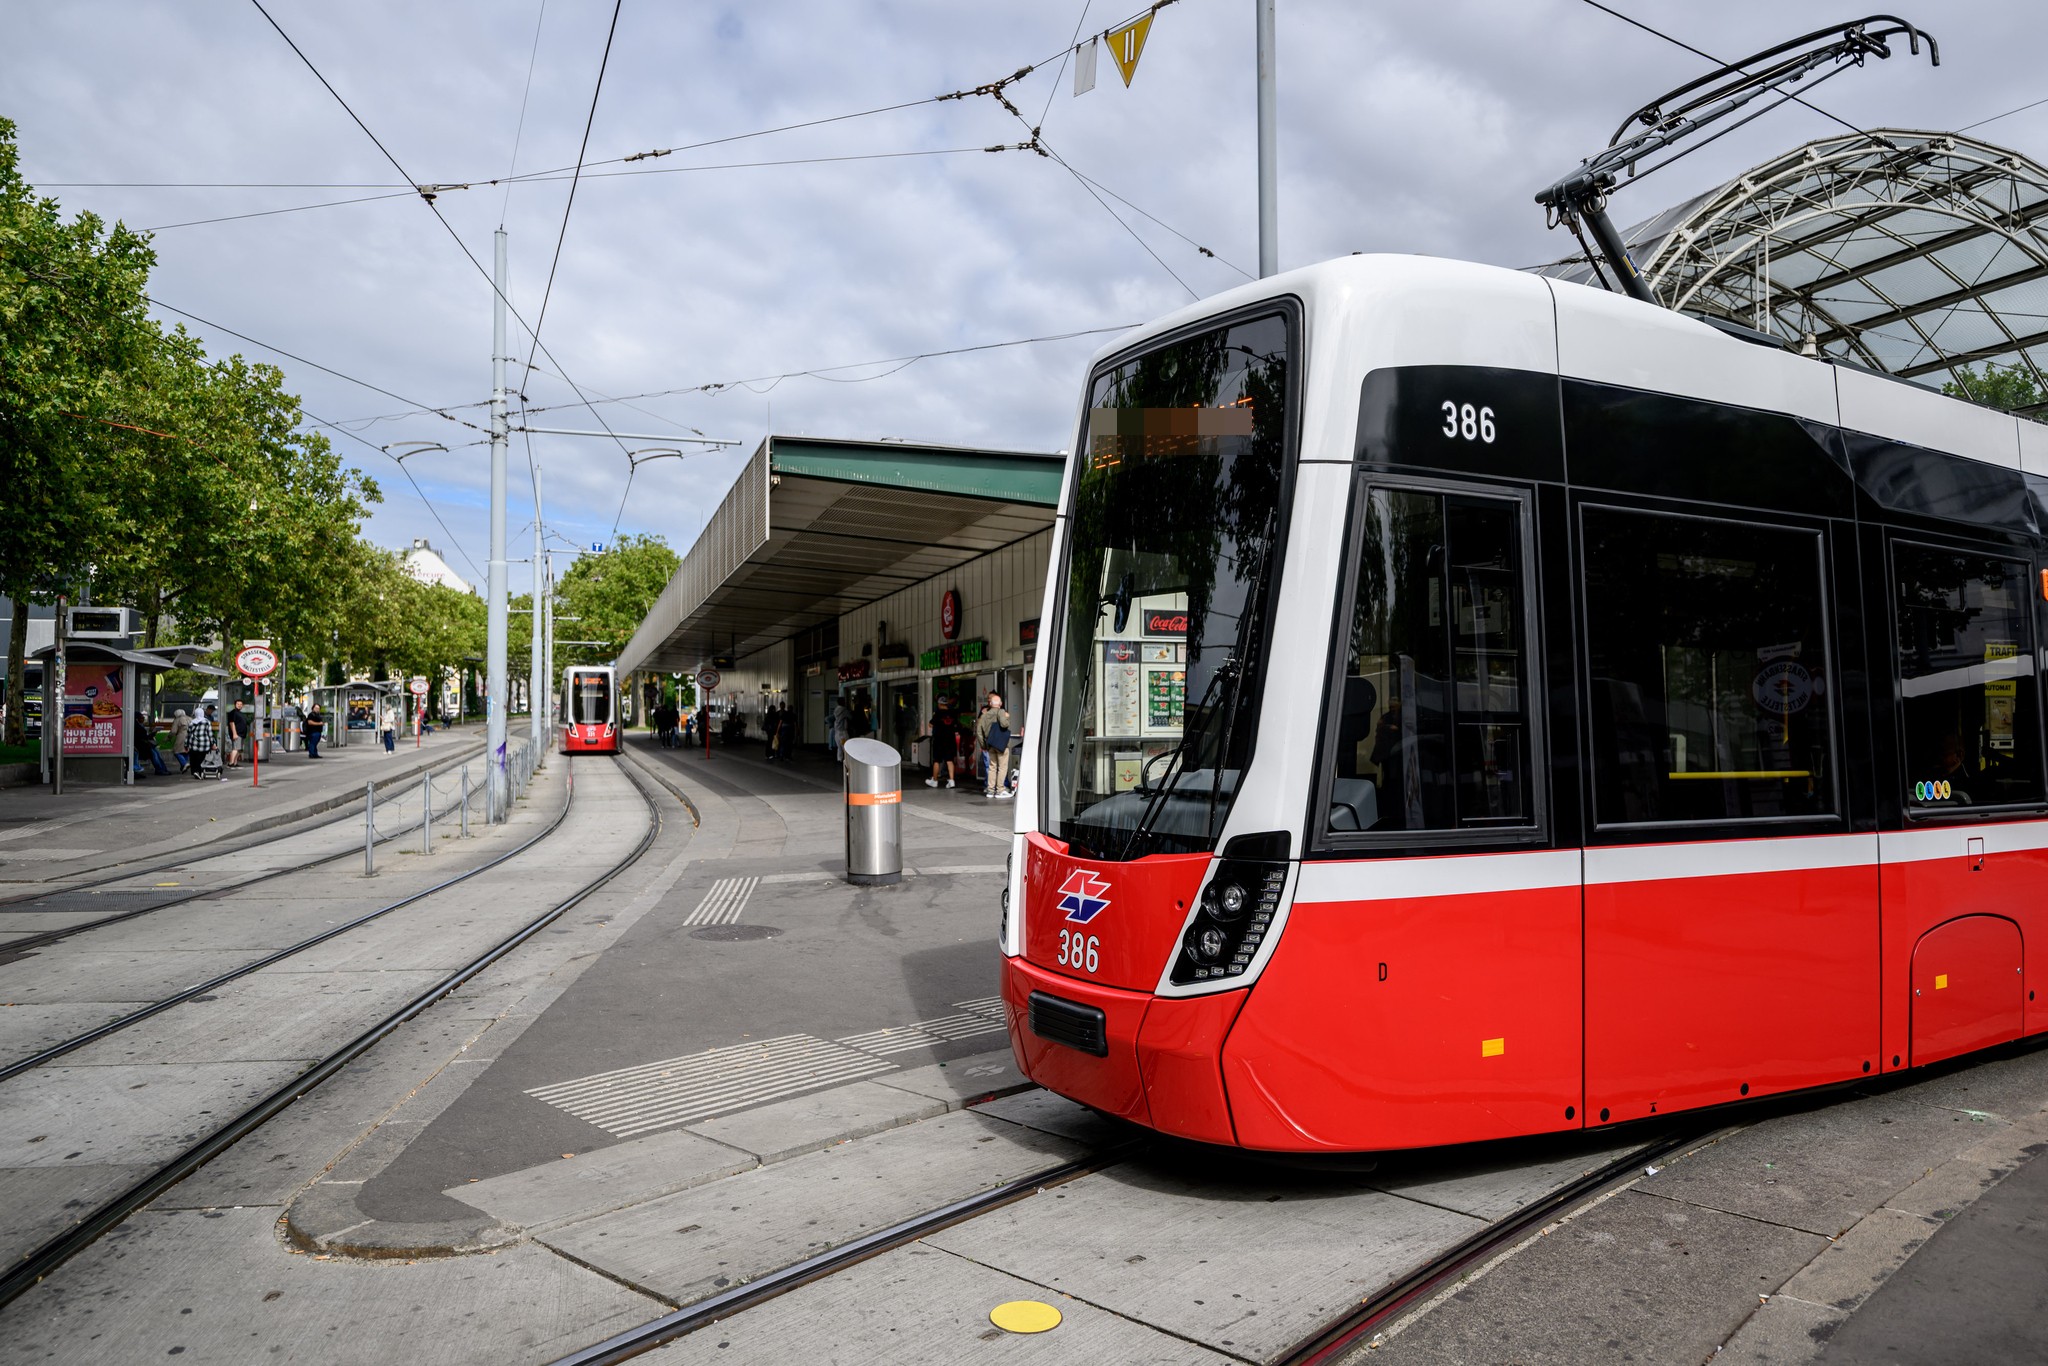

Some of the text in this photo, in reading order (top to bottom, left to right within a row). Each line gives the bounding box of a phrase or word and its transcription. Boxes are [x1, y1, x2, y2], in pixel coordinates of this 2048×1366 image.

[1441, 400, 1495, 443] 386
[241, 650, 272, 660] STRASSENBAHN
[962, 641, 982, 663] SUSHI
[243, 664, 271, 672] HALTESTELLE
[94, 722, 113, 730] WIR
[1057, 928, 1100, 973] 386
[1378, 962, 1388, 982] D
